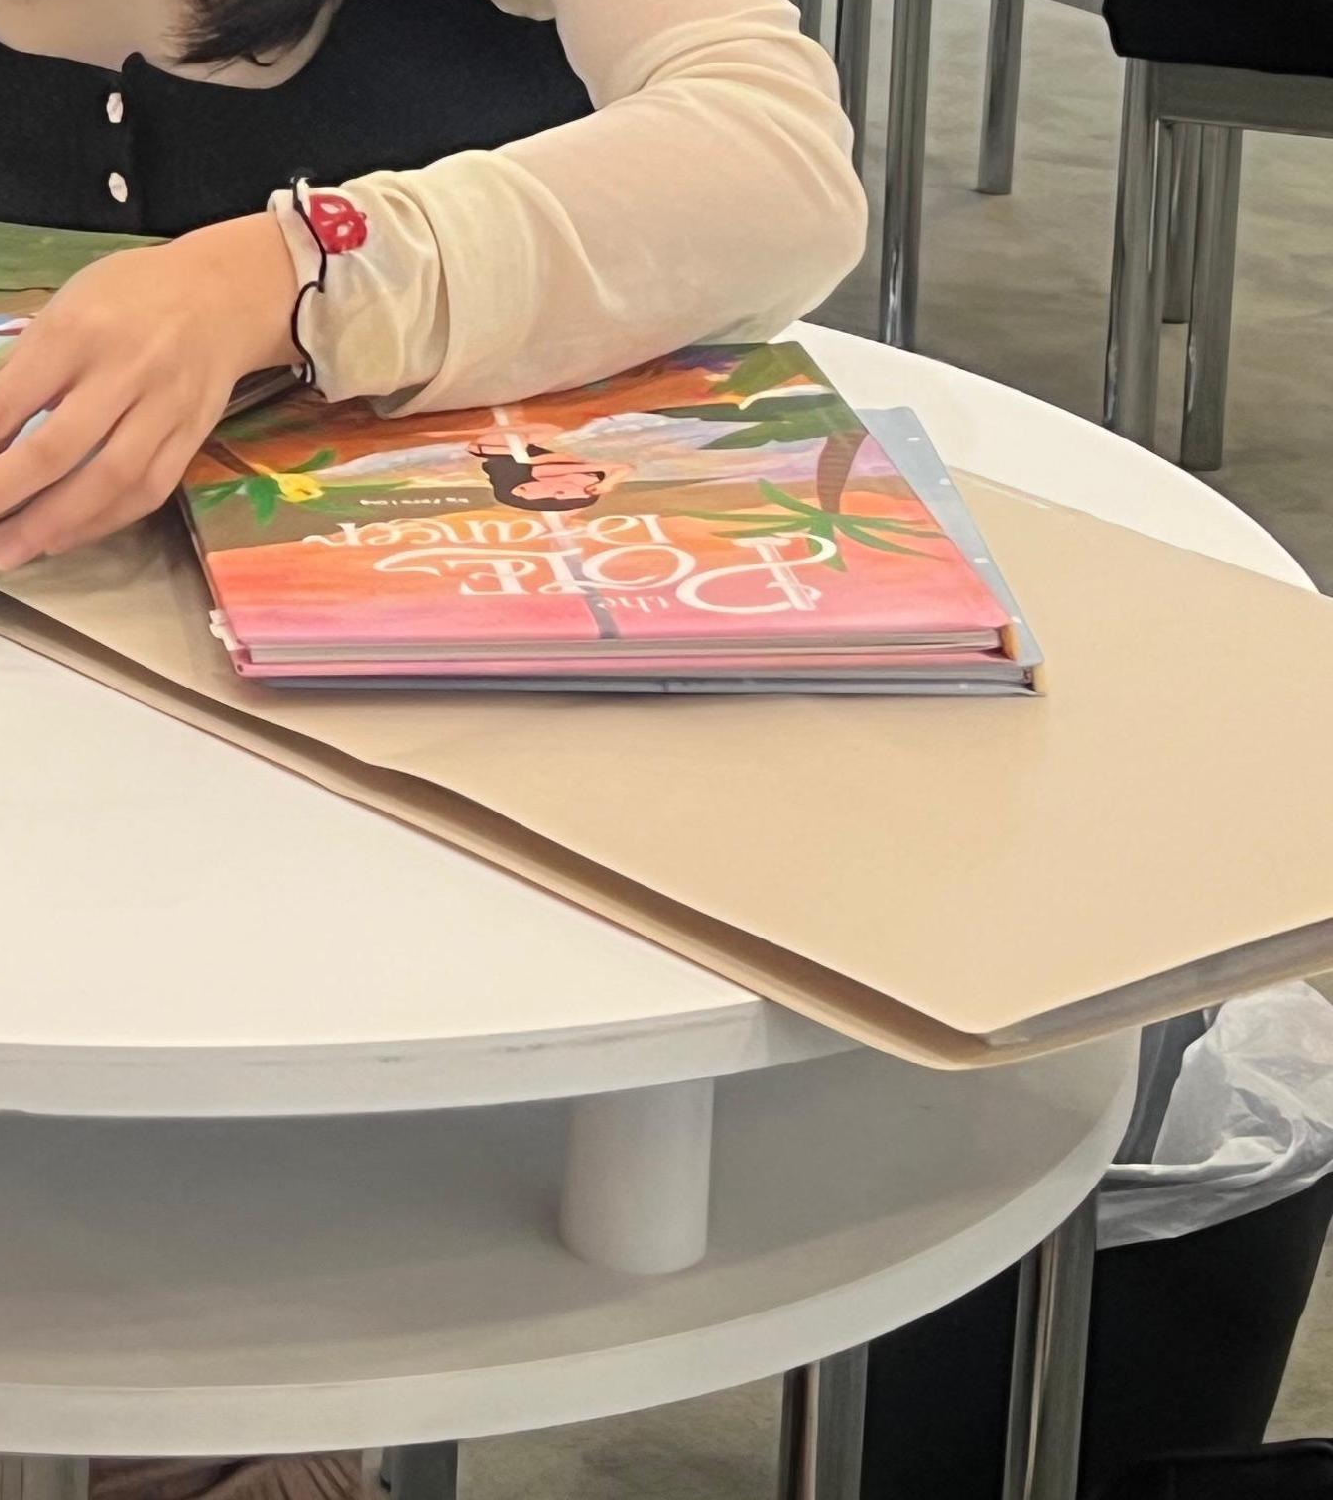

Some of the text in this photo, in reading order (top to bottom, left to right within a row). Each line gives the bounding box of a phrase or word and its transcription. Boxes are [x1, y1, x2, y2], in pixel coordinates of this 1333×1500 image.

[302, 512, 672, 549] Dancer
[373, 532, 838, 614] POLE
[597, 595, 670, 613] the
